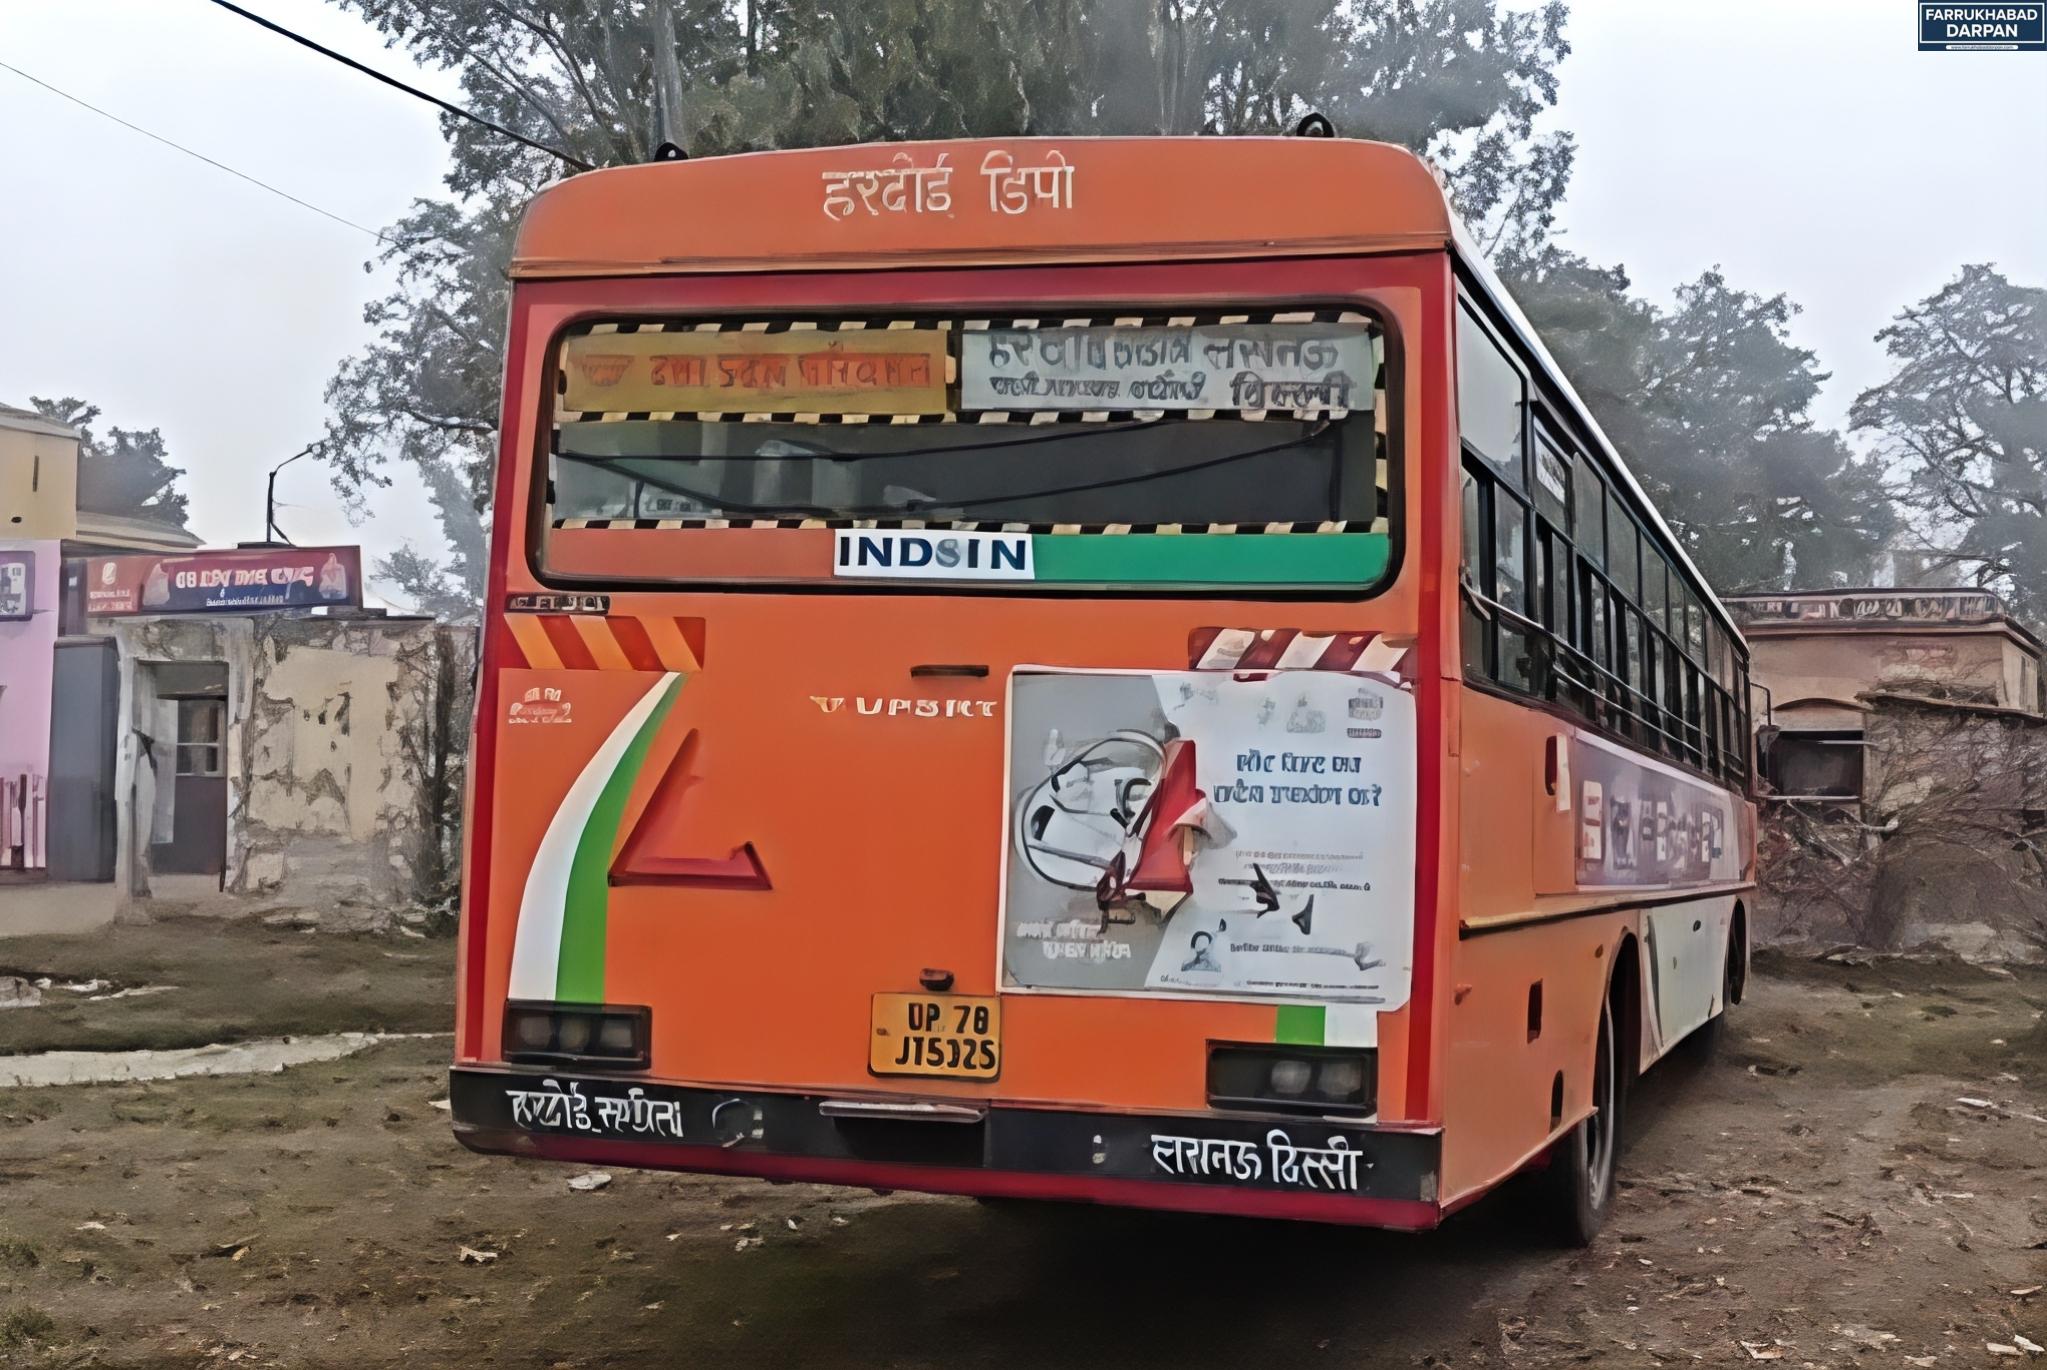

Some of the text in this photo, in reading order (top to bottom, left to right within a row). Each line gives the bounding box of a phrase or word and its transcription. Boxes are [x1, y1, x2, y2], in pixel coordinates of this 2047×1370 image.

[980, 150, 1075, 214] डिपो
[908, 1002, 989, 1035] UP 78
